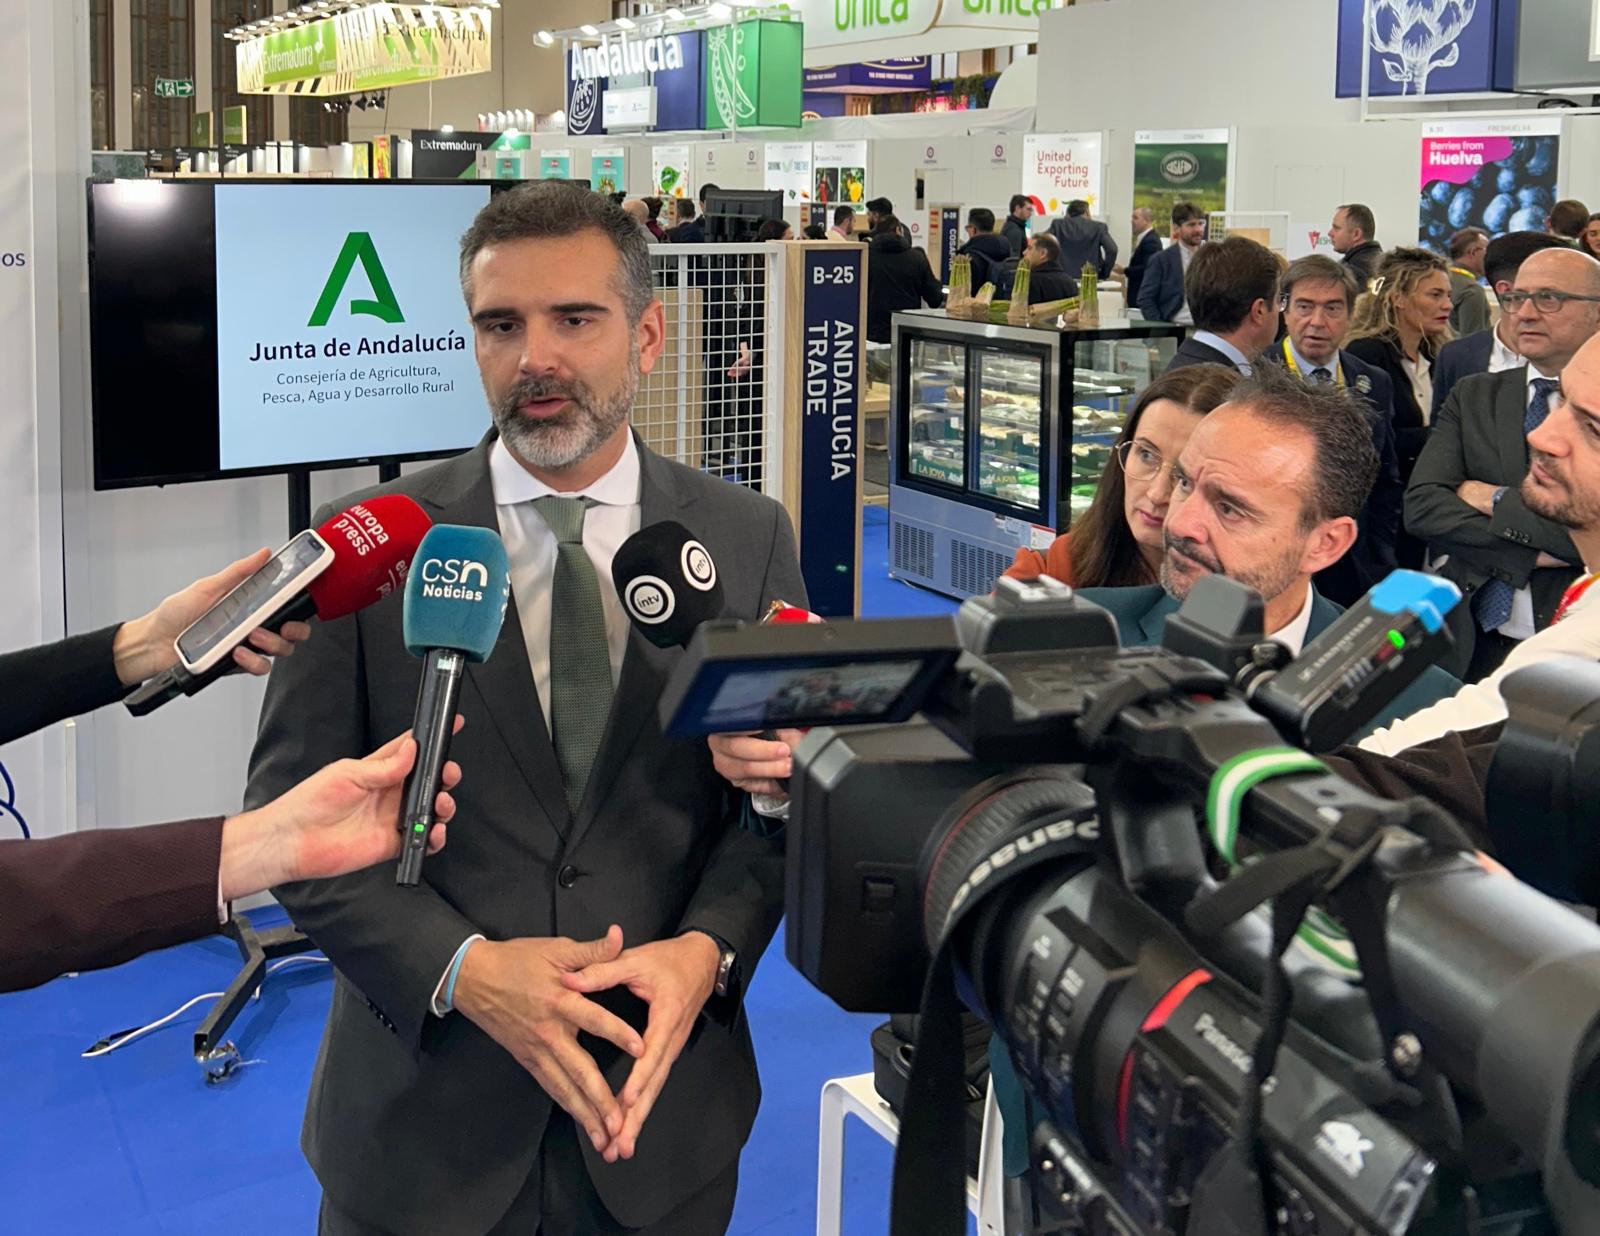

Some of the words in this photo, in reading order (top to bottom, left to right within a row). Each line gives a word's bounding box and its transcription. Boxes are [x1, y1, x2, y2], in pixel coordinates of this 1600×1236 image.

[264, 42, 314, 74] Extremadura
[420, 139, 482, 151] Extremadura
[1430, 142, 1460, 150] Berries
[1462, 141, 1484, 150] from
[1037, 149, 1071, 162] United
[1430, 151, 1483, 165] Huelva
[1037, 162, 1088, 177] Exporting
[1055, 176, 1088, 188] Future
[0, 253, 26, 267] os
[813, 266, 854, 284] B-25
[249, 341, 316, 362] Junta
[323, 337, 351, 357] de
[357, 329, 466, 356] Andalucía
[276, 369, 346, 385] Consejería
[349, 368, 366, 381] de
[368, 365, 441, 381] Agricultura,
[806, 320, 828, 416] TRADE
[262, 391, 305, 405] Pesca,
[308, 388, 341, 403] Agua
[344, 390, 352, 402] y
[354, 383, 419, 399] Desarrollo
[422, 380, 455, 393] Rural
[831, 320, 856, 481] ANDALUCÍA
[350, 505, 390, 545] europa
[332, 518, 371, 556] press
[423, 584, 484, 601] Noticias
[638, 593, 660, 608] intv
